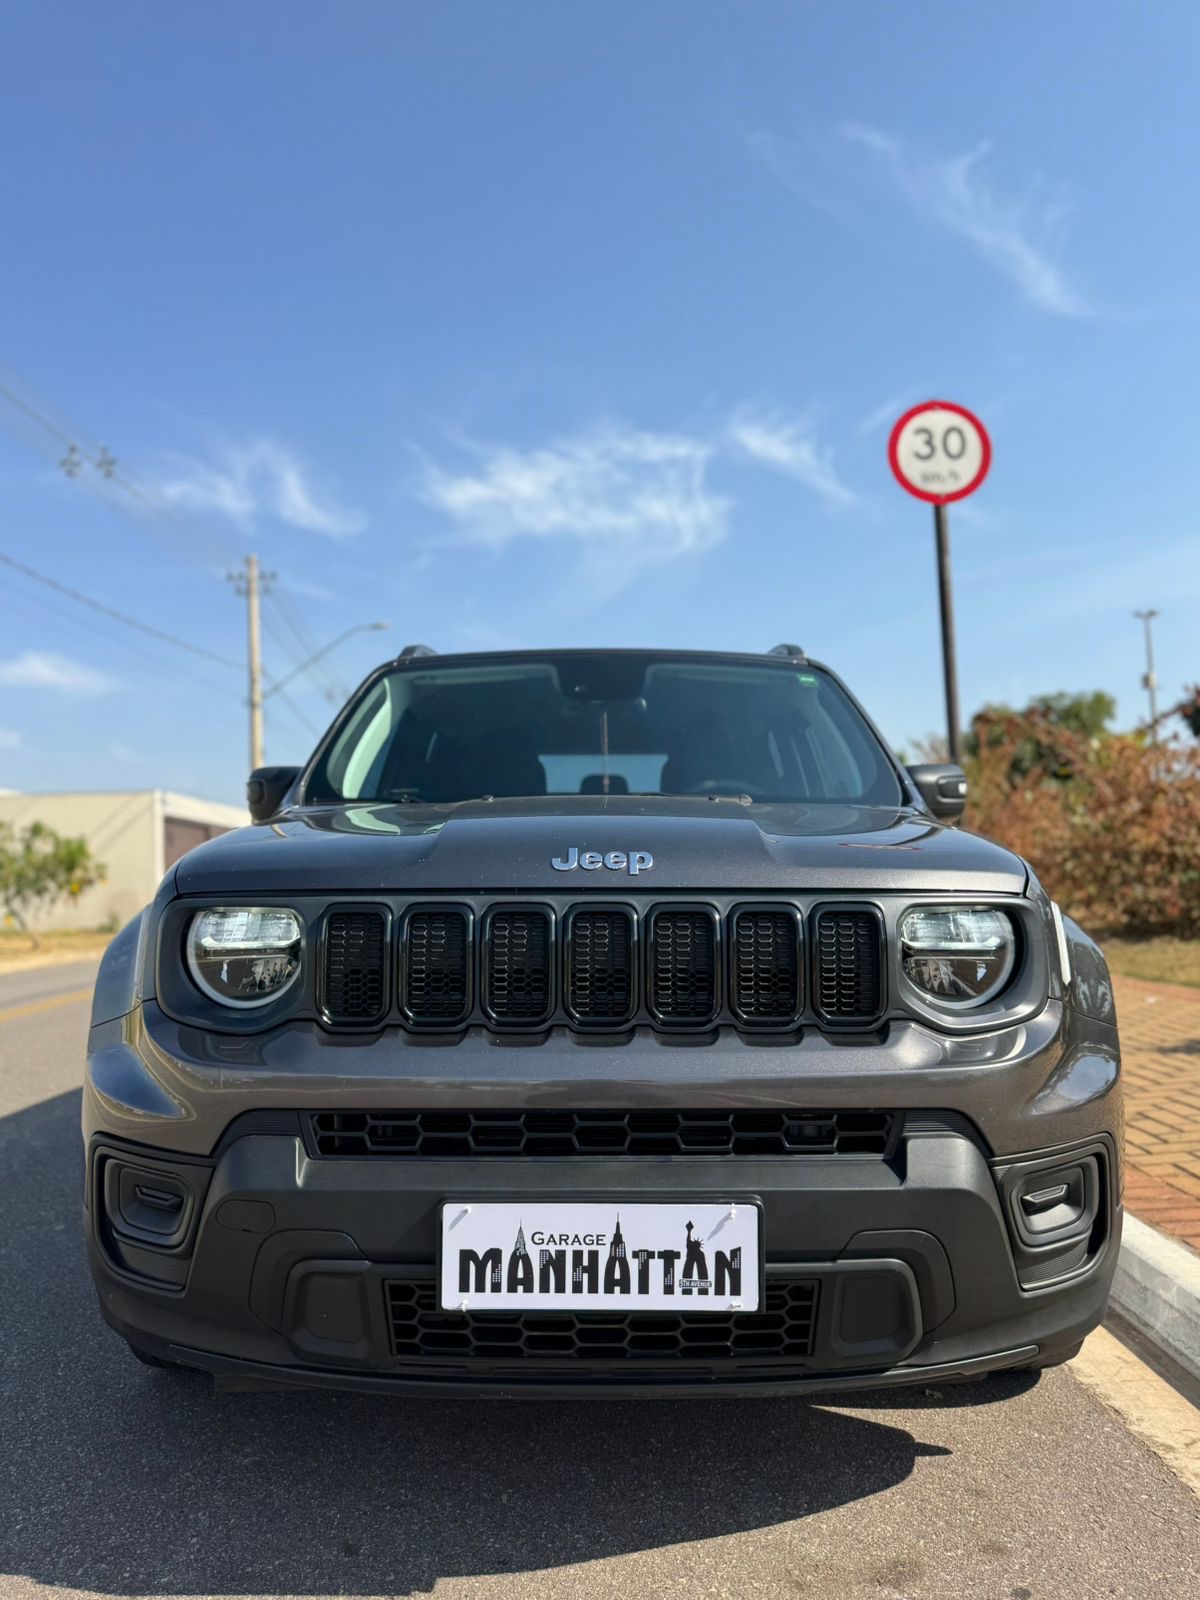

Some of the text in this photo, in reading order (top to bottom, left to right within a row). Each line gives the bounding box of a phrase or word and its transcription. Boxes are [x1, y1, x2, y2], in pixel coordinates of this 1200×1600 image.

[913, 427, 967, 461] 30
[551, 847, 654, 875] Jeep
[458, 1220, 742, 1296] MANHATTAN
[679, 1279, 690, 1288] 5TH
